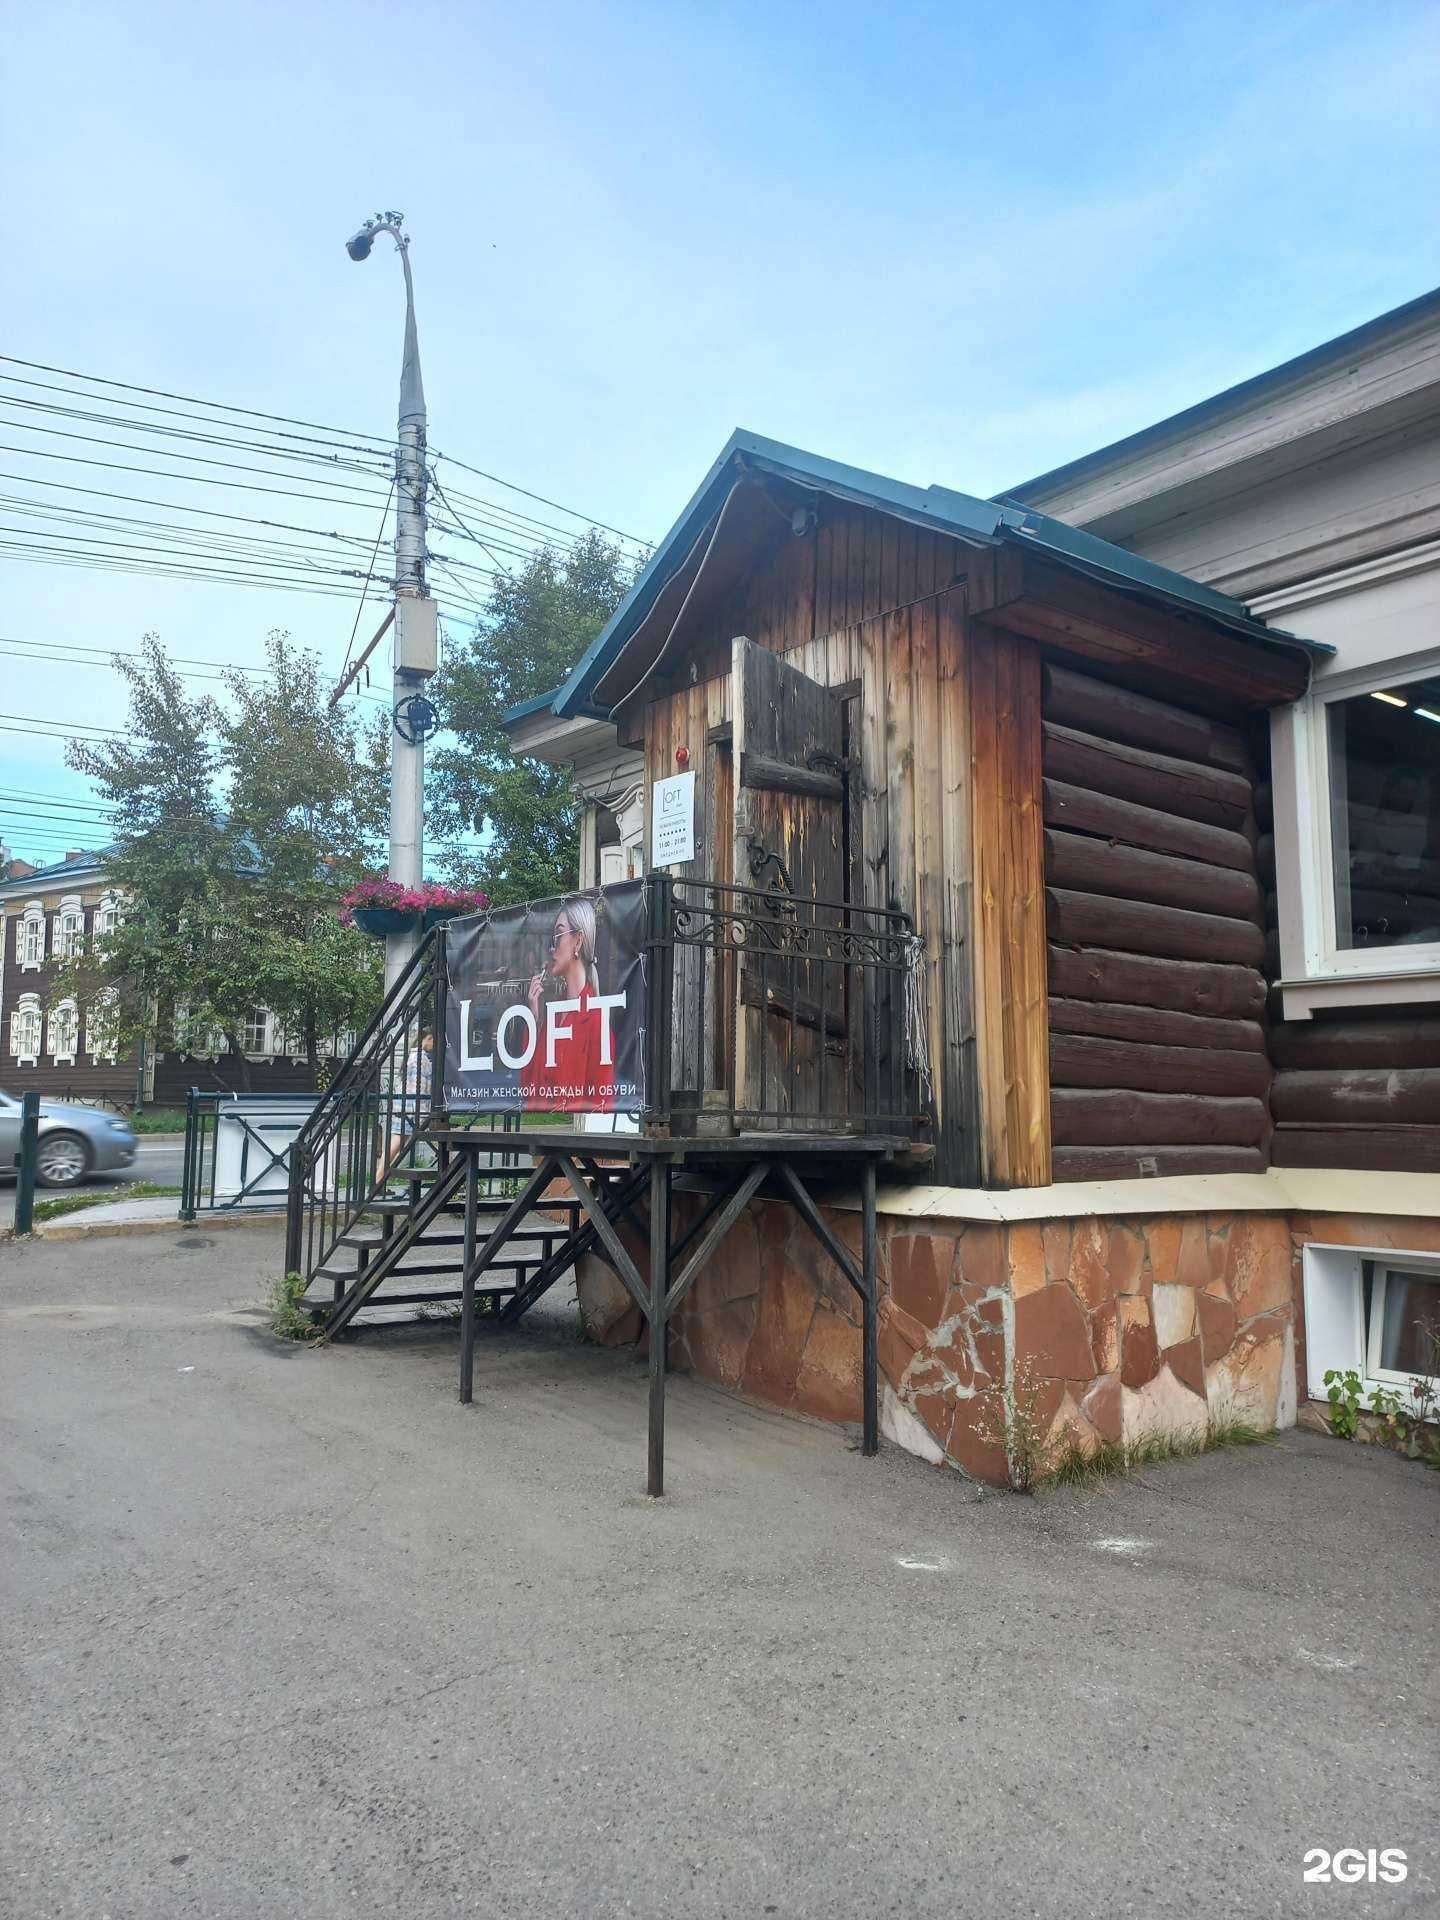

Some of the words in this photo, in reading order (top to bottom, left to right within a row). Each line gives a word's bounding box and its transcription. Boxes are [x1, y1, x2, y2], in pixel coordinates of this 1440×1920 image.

[662, 787, 682, 812] LOFT
[458, 990, 627, 1073] LOFT
[451, 1084, 490, 1098] МАГАЗИН
[492, 1083, 536, 1098] ЖЕНСКОЙ
[539, 1085, 584, 1099] ОДЕЖДЫ
[588, 1085, 595, 1096] И
[599, 1084, 637, 1096] ОБУВИ
